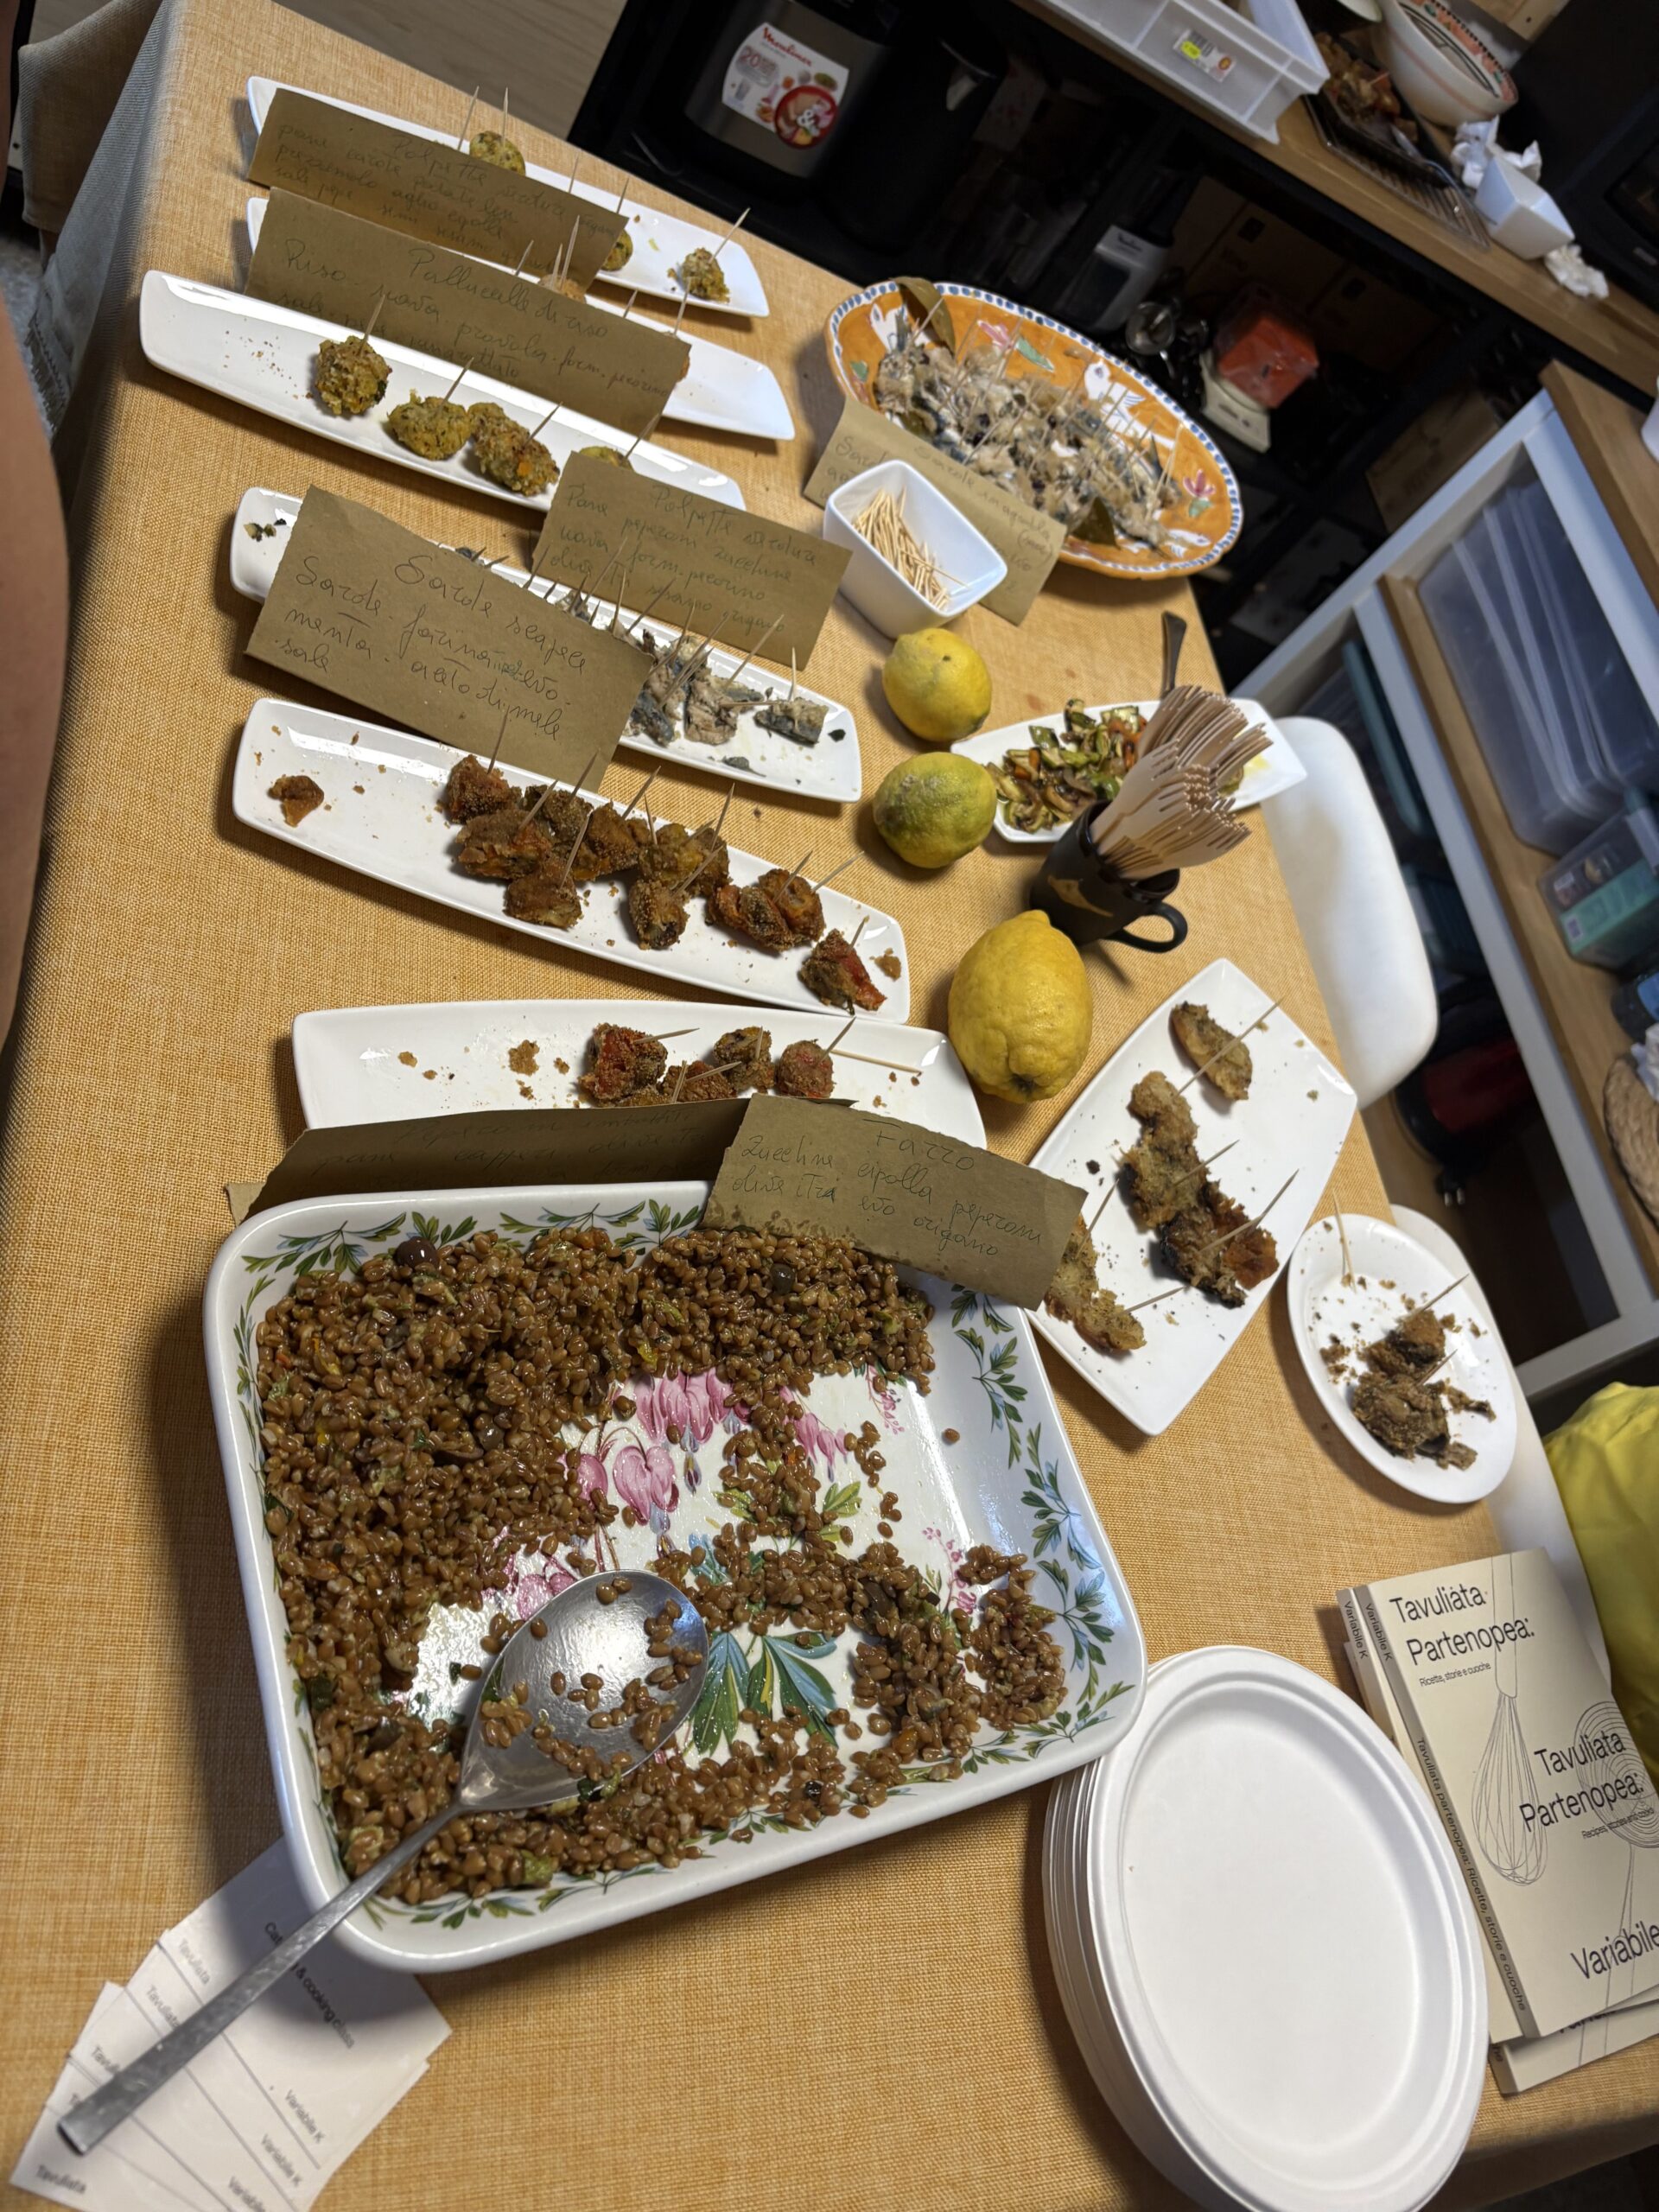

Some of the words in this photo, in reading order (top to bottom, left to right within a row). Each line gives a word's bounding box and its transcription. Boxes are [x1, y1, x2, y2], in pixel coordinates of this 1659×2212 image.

[763, 27, 812, 67] Moulinex
[284, 238, 346, 282] Riso
[836, 436, 887, 467] Sard
[394, 555, 493, 619] Sarde
[1344, 1600, 1364, 1648] Variabile
[1359, 1649, 1370, 1660] K
[1365, 1603, 1388, 1651] Variabile
[1383, 1652, 1394, 1662] K
[1406, 1617, 1535, 1666] Partenopea:
[1534, 1730, 1627, 1776] Tavuliata
[1519, 1772, 1644, 1833] Partenopea:
[1416, 1738, 1442, 1790] Tavuliata
[1436, 1791, 1470, 1866] partenopea:
[1466, 1867, 1488, 1914] Ricette,
[1484, 1916, 1503, 1950] storie
[1499, 1952, 1507, 1961] e
[1503, 1963, 1526, 2012] cuoche
[177, 1938, 211, 1985] Tavuliata
[303, 1978, 335, 2023] cooking
[285, 2089, 316, 2134] Variabile
[314, 2132, 326, 2143] K
